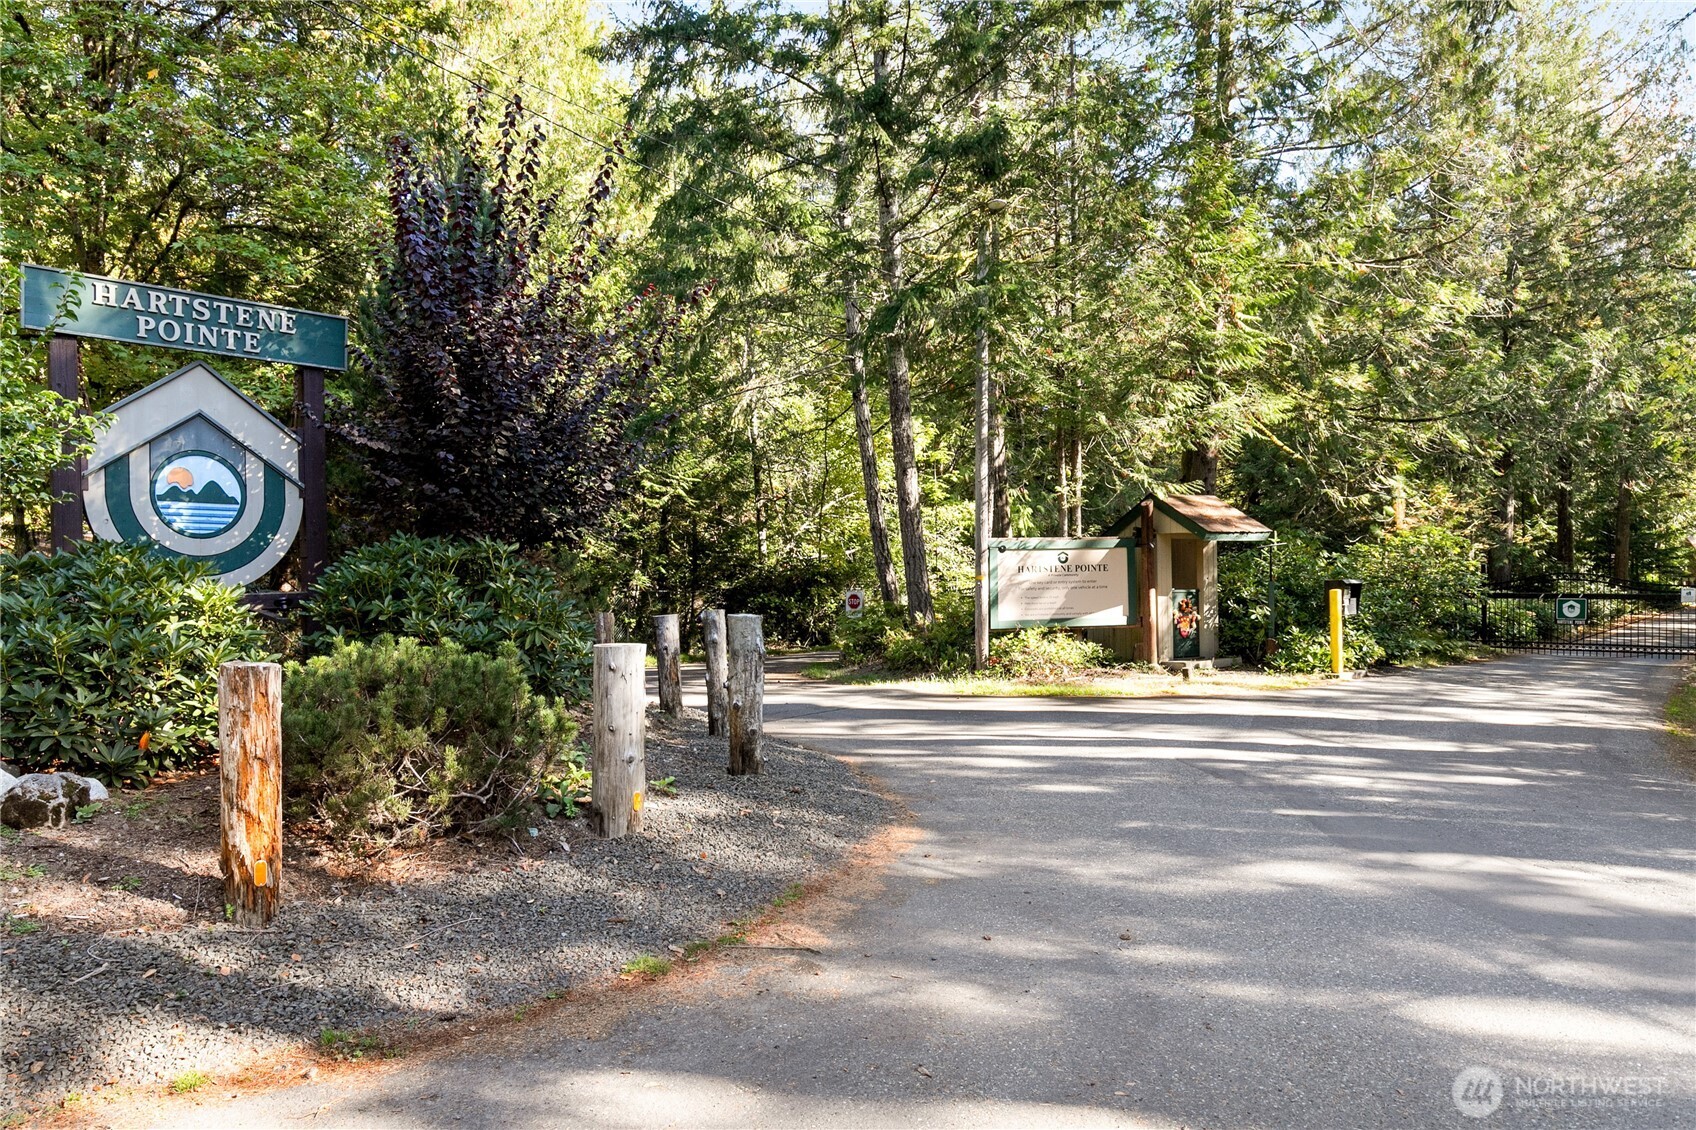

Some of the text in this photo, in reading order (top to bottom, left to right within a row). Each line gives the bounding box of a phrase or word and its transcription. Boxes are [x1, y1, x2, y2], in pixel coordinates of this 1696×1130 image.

[92, 281, 297, 335] HARTSTENE
[136, 315, 261, 354] POINTE
[1075, 564, 1109, 573] POINTE
